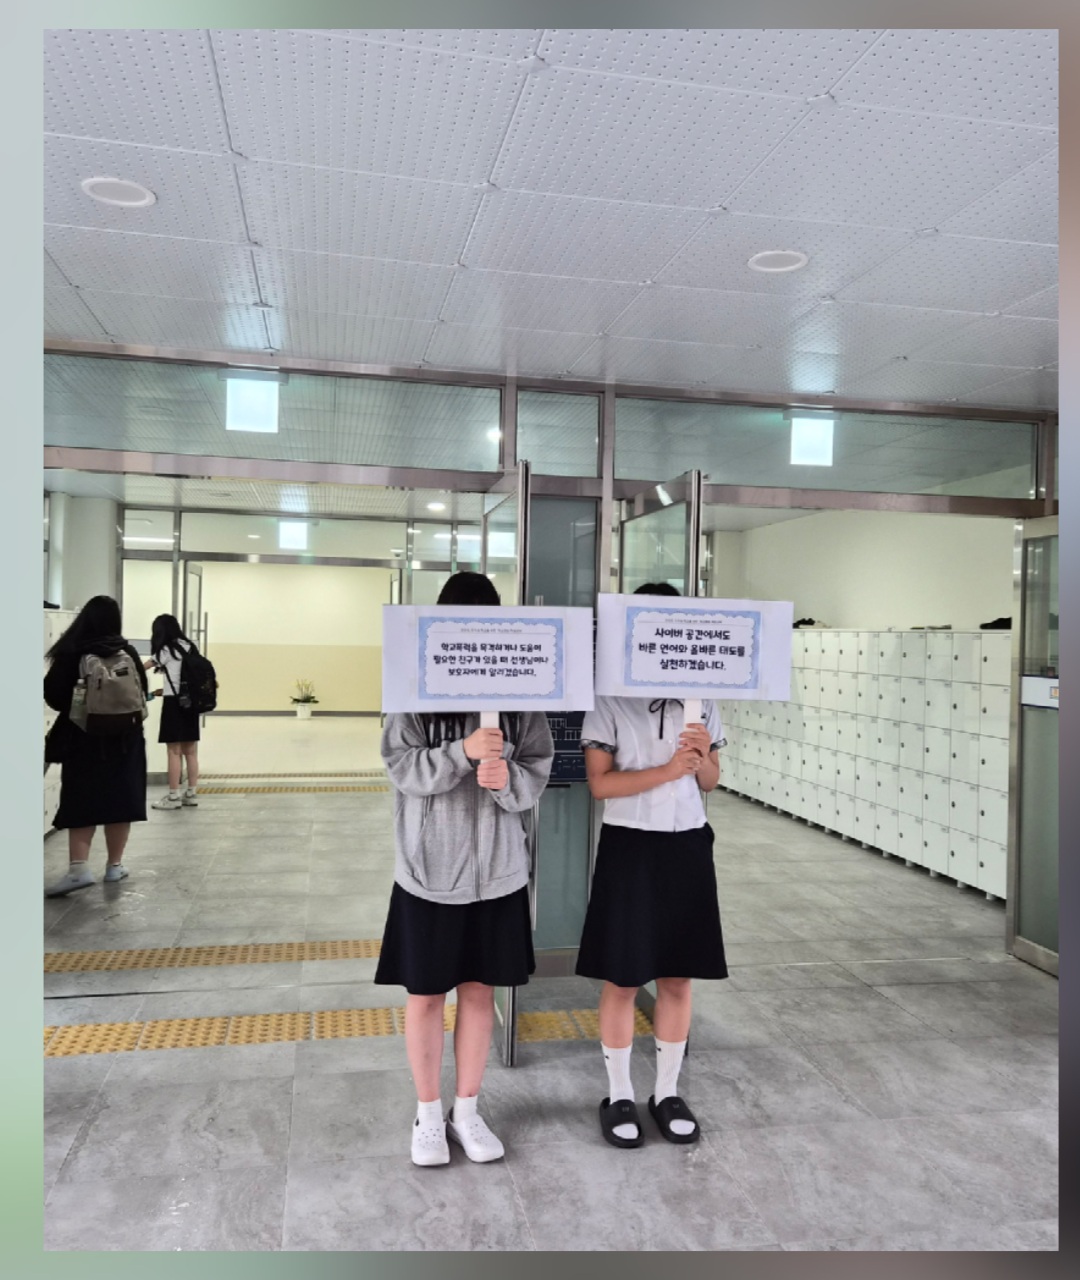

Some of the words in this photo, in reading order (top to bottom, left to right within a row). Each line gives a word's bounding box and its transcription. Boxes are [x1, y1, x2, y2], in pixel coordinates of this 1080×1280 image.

[654, 627, 683, 639] 사이버
[685, 628, 731, 641] 공간에서도
[441, 643, 478, 653] 학교폭력을
[480, 643, 518, 652] 목격하거나
[519, 643, 542, 652] 도움이
[638, 643, 657, 654] 바른
[659, 644, 688, 654] 언어와
[690, 644, 716, 656] 올바른
[719, 645, 746, 657] 태도를
[433, 655, 456, 665] 필요한
[458, 655, 481, 664] 친구가
[483, 655, 498, 664] 있을
[510, 656, 548, 665] 선생님이나
[660, 659, 727, 671] 실천하겠습니다.
[448, 667, 487, 677] 보호자에게
[489, 668, 537, 677] 알리겠습니다.
